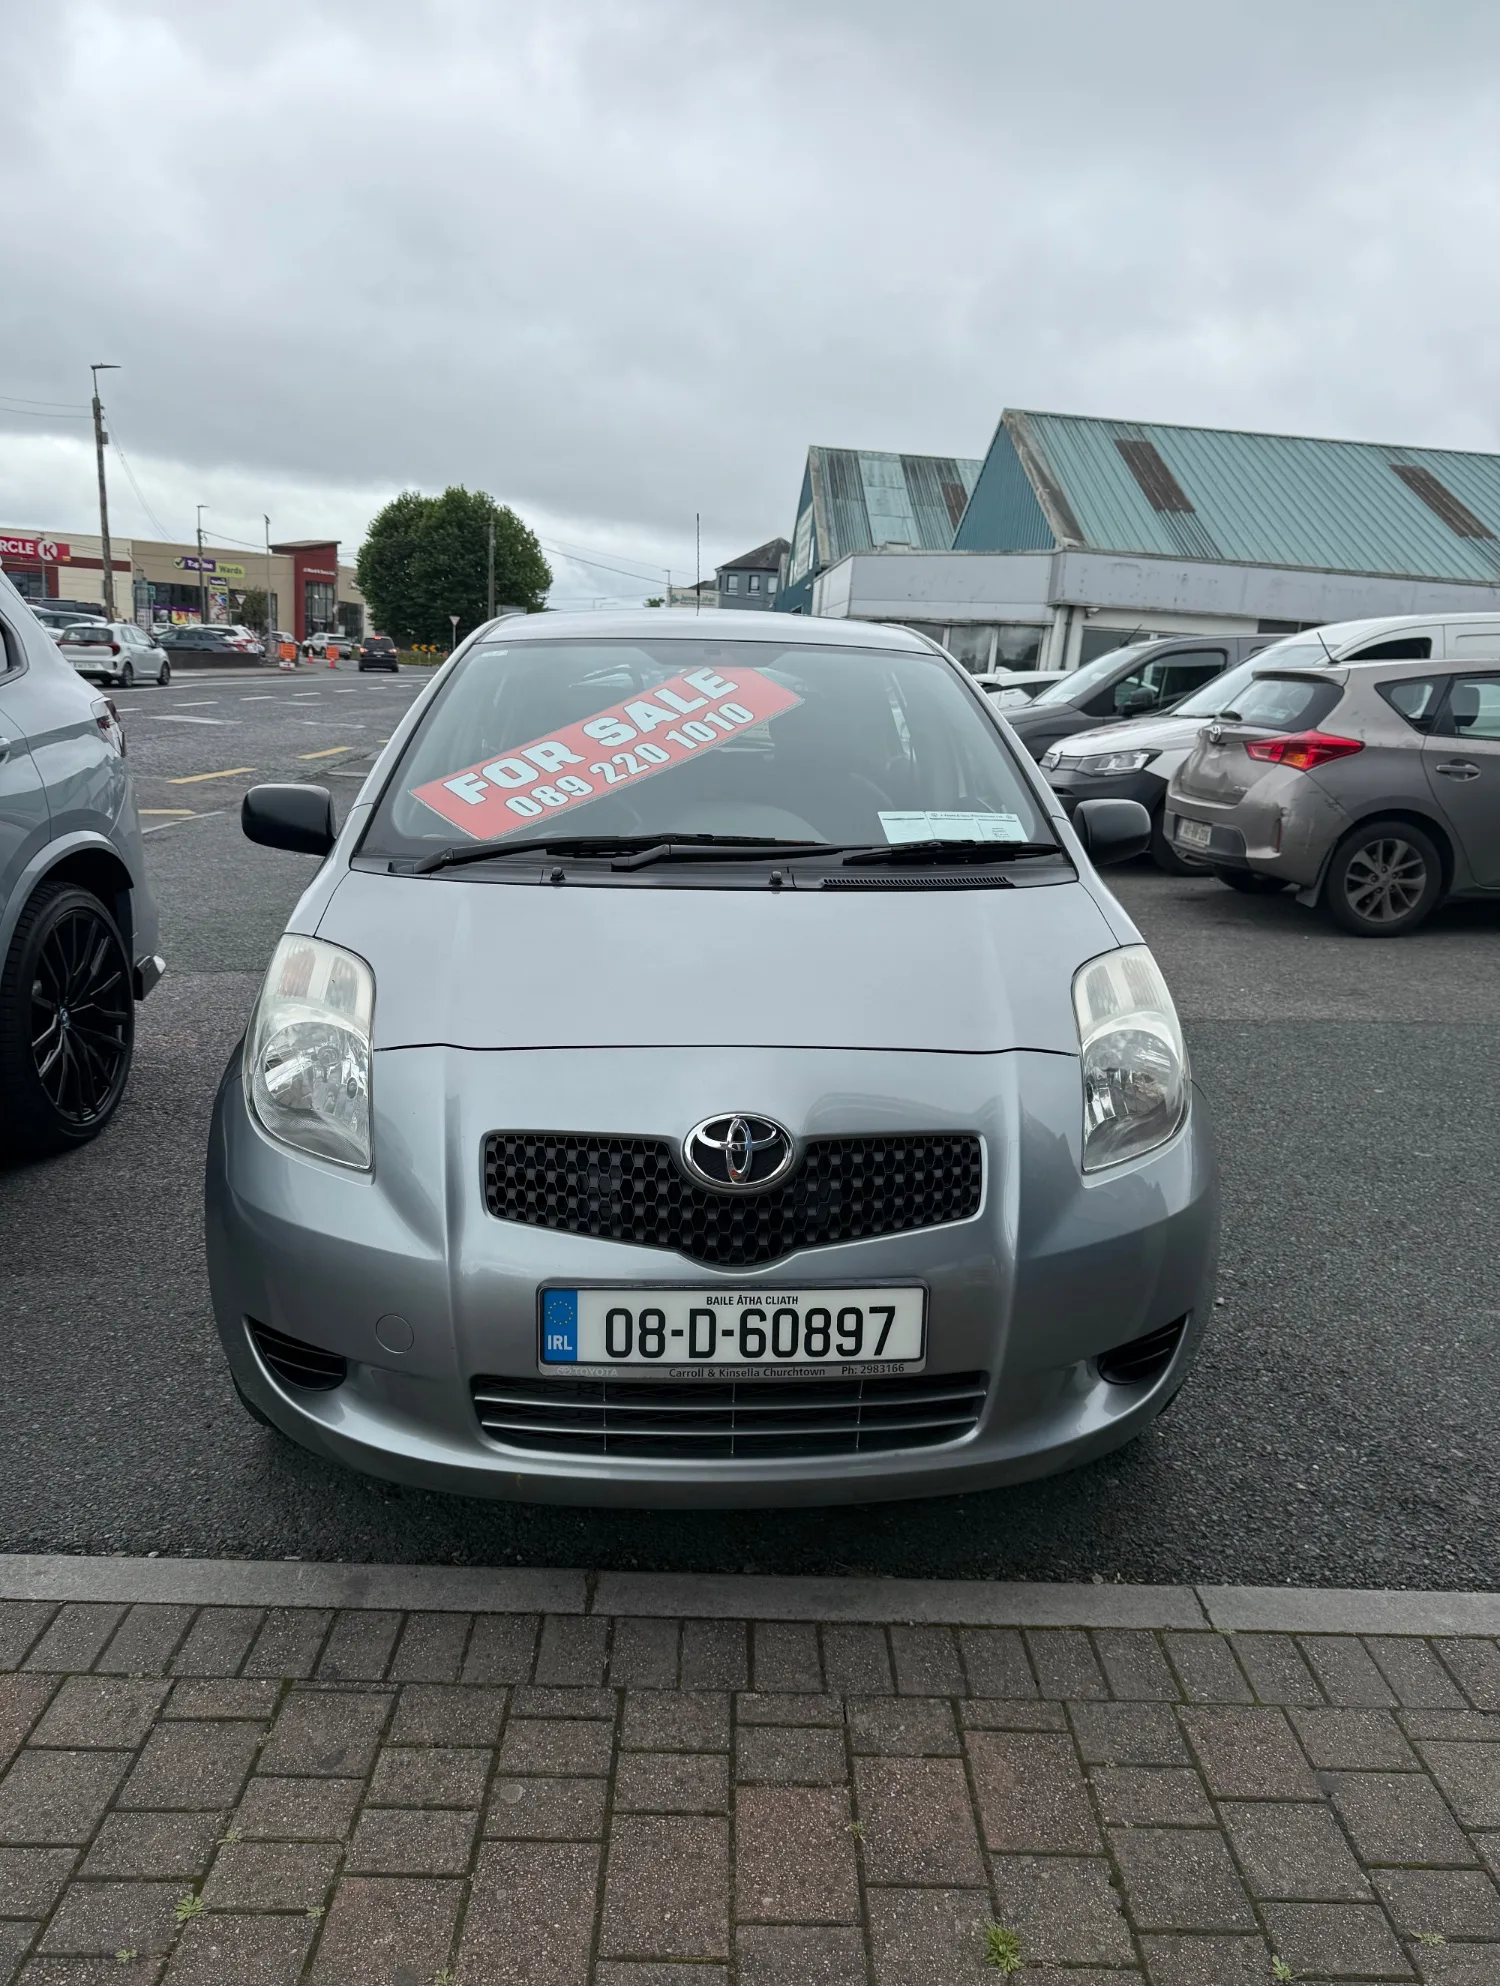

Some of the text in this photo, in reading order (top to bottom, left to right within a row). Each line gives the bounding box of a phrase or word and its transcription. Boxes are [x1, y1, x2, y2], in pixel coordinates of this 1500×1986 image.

[43, 543, 57, 560] K
[219, 565, 243, 574] Wards
[442, 667, 739, 805] FOR SALE
[504, 702, 755, 817] 089 220 1010
[706, 1296, 734, 1306] BAILE
[765, 1295, 799, 1305] CLIATH
[605, 1306, 896, 1359] 08-D-60897
[547, 1335, 573, 1351] IRL
[573, 1367, 619, 1377] TOYOTA
[669, 1363, 905, 1378] Carroll & Kinsella Churchtown Ph: 2983166
